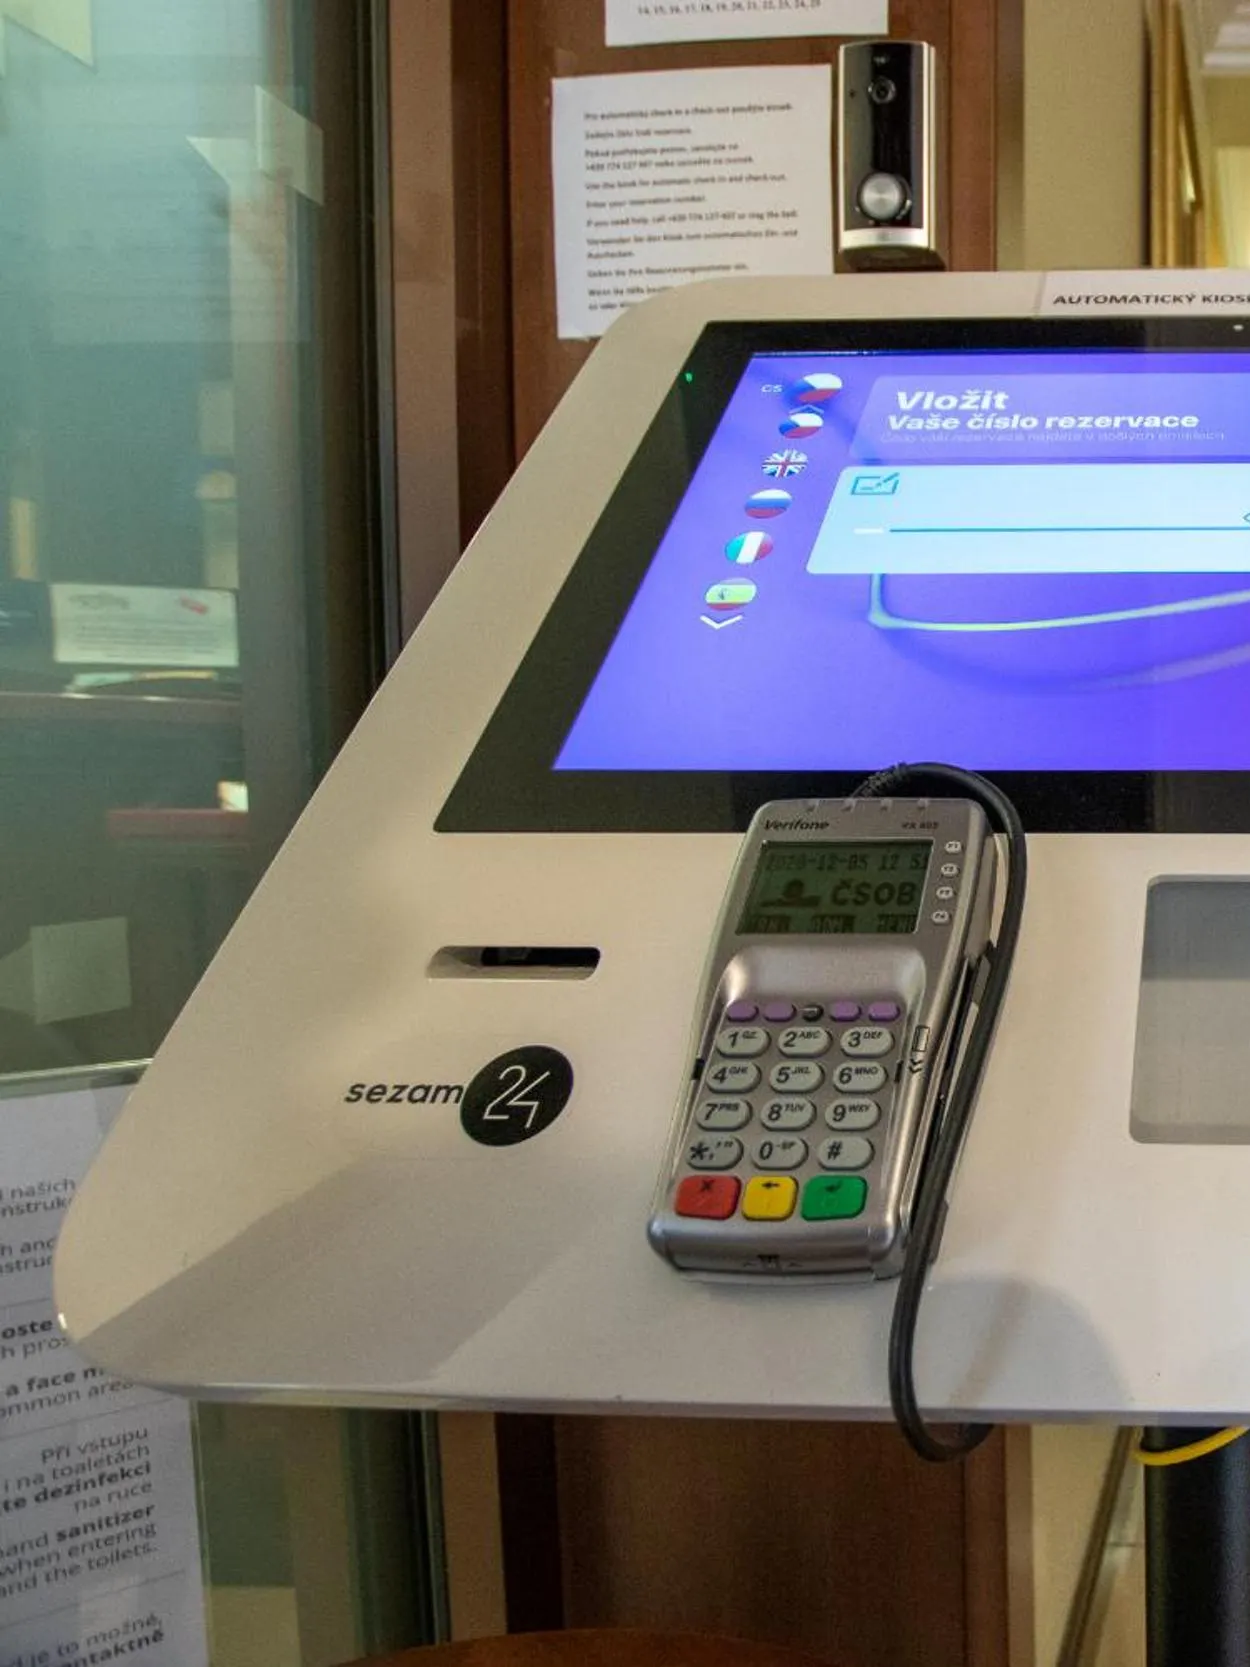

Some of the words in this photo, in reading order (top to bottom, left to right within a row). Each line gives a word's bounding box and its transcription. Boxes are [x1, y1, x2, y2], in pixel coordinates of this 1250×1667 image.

[1053, 292, 1196, 305] AUTOMATICKÝ
[896, 390, 1010, 411] Vložit
[888, 412, 961, 431] Vaše
[967, 412, 1039, 431] číslo
[1045, 413, 1201, 430] rezervace
[764, 820, 830, 831] Verifone
[831, 877, 917, 906] ČSOB
[728, 1031, 741, 1048] 1
[783, 1031, 797, 1048] 2
[799, 1031, 820, 1040] ABC
[848, 1031, 861, 1048] 3
[863, 1031, 883, 1039] DEF
[713, 1067, 728, 1083] 4
[775, 1067, 790, 1083] 5
[839, 1067, 853, 1085] 6
[344, 1082, 466, 1105] sezam
[704, 1103, 718, 1121] 7
[767, 1103, 783, 1122] 8
[832, 1104, 846, 1122] 9
[759, 1141, 773, 1160] 0
[6, 1384, 19, 1397] a
[27, 1370, 76, 1393] face
[41, 1444, 70, 1465] Při
[77, 1428, 148, 1454] vstupu
[17, 1473, 45, 1491] na
[52, 1445, 150, 1480] toaletách
[34, 1460, 151, 1504] dezinfekci
[74, 1496, 101, 1513] na
[107, 1482, 152, 1503] ruce
[0, 1531, 48, 1558] and
[56, 1504, 155, 1543] sanitizer
[0, 1551, 60, 1578] when
[68, 1522, 157, 1559] entering
[45, 1563, 81, 1584] the
[88, 1541, 160, 1572] toilets.
[57, 1640, 80, 1658] to
